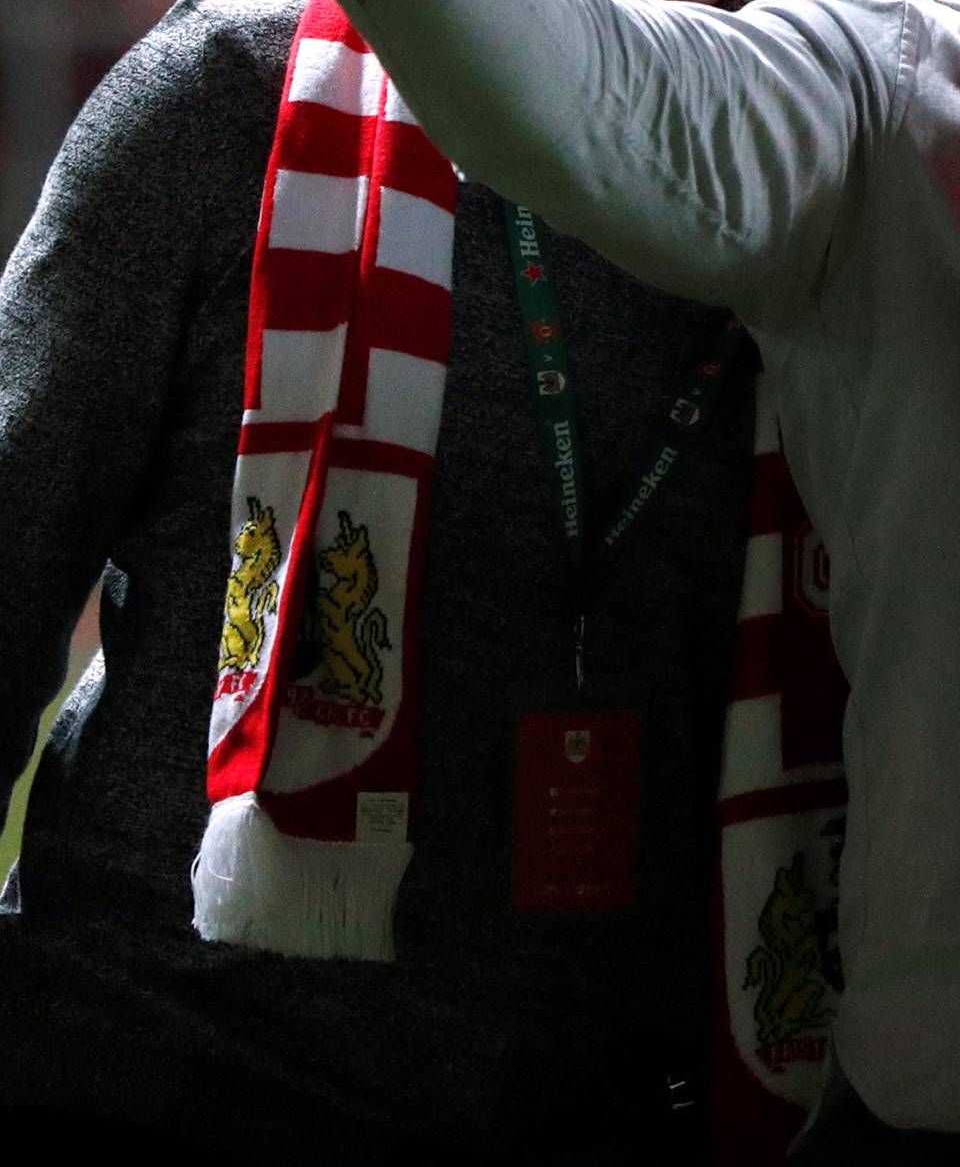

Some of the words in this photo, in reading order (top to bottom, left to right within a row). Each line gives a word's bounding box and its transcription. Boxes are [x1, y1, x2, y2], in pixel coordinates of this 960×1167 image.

[516, 205, 541, 258] Hein
[553, 419, 578, 538] Heineken
[604, 445, 680, 546] Heineken
